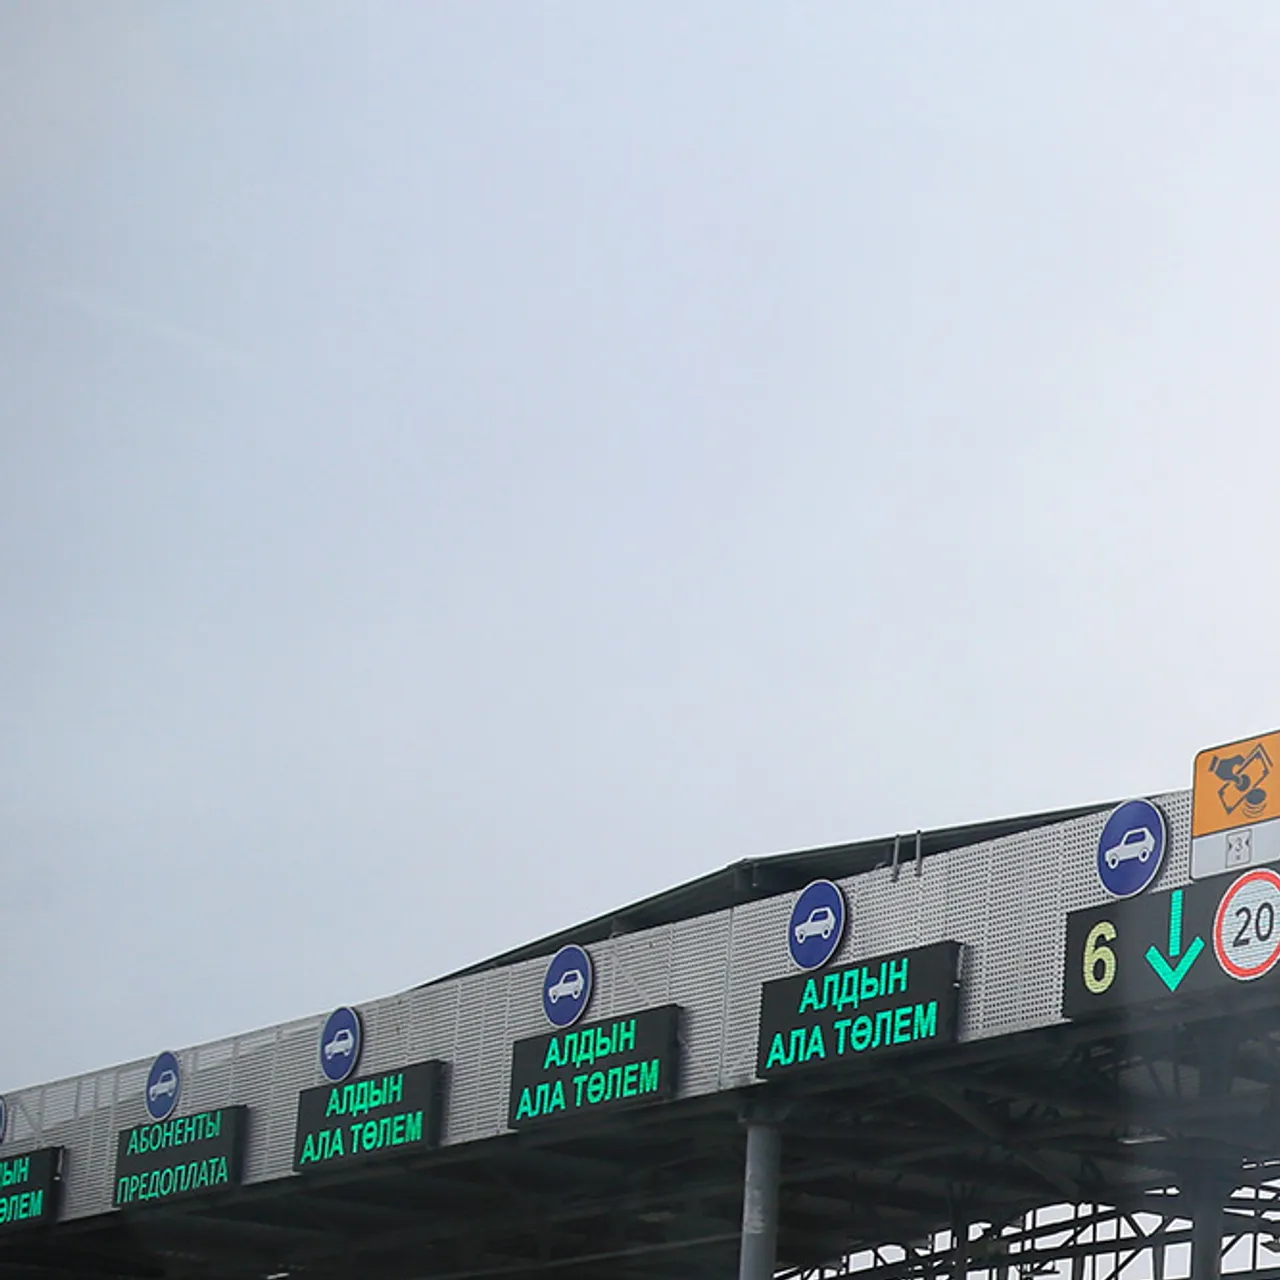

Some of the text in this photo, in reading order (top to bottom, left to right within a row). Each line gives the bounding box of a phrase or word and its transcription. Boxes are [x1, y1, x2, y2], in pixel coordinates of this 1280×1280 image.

[1232, 902, 1275, 948] 20
[1082, 921, 1118, 994] 6
[799, 958, 909, 1013] АЛДЫН
[543, 1019, 637, 1069] АЛДЫН
[766, 1001, 938, 1069] АЛА ТӨЛЕМ
[325, 1073, 404, 1117] АЛДЫН
[515, 1059, 660, 1120] АЛА ТӨЛЕМ
[126, 1110, 223, 1155] АБОНЕНТЫ
[300, 1111, 424, 1165] АЛА ТӨЛЕМ
[116, 1156, 228, 1204] ПРЕДОПЛАТА
